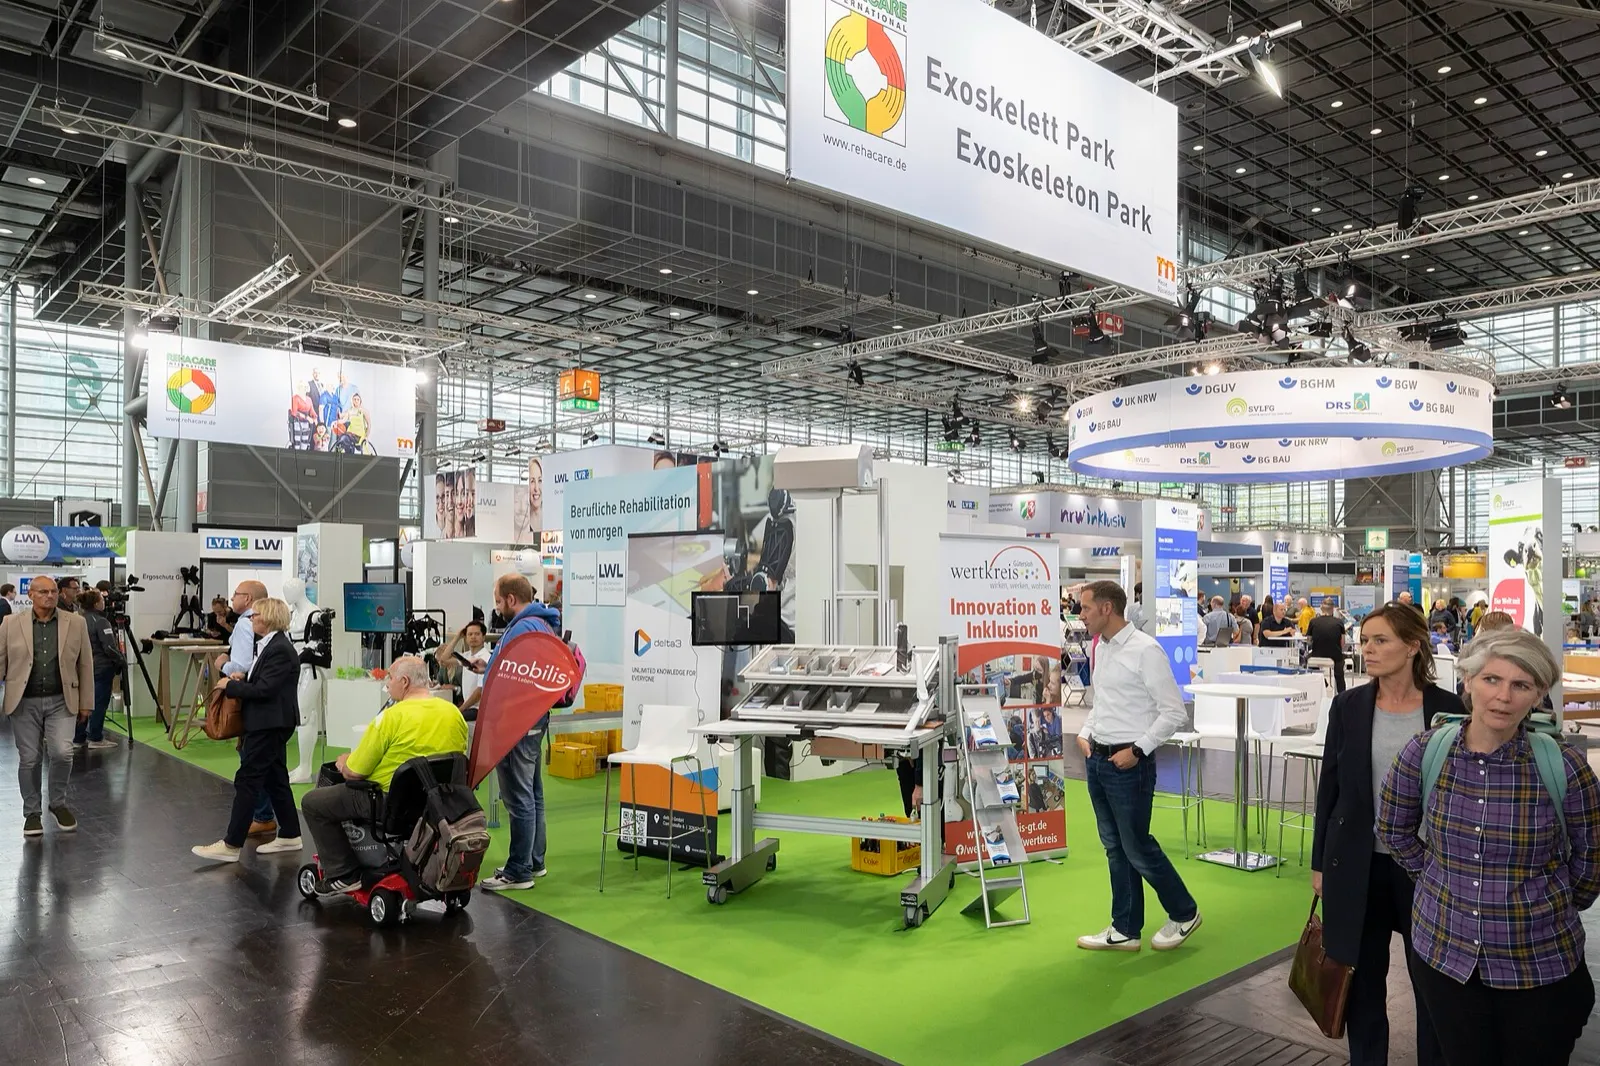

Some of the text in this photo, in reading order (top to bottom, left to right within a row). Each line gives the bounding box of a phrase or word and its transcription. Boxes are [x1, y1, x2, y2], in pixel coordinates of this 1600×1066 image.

[926, 56, 1116, 170] Exoskelett Park
[823, 133, 907, 172] www.rehacare.de
[956, 127, 1153, 235] Exoskeleton Park
[167, 353, 217, 367] REHACARE
[583, 380, 593, 398] 6
[1205, 383, 1236, 394] DGUV
[1300, 378, 1335, 389] BGHM
[1394, 379, 1418, 390] BGW
[1458, 385, 1480, 398] UK NRW
[1125, 393, 1157, 406] UK NRW
[1248, 405, 1275, 413] SVLFG
[1326, 401, 1351, 410] DRS
[1426, 403, 1455, 415] BG BAU
[1082, 406, 1093, 418] BGW
[1097, 418, 1121, 431] BG BAU
[1294, 438, 1328, 447] UK NRW
[1258, 455, 1290, 464] BG BAU
[554, 473, 569, 483] LWL
[570, 494, 691, 519] Berufliche Rehabilitation
[1060, 504, 1126, 528] nrw inklusiv
[14, 533, 45, 544] LWL
[570, 525, 623, 541] von morgen
[208, 538, 232, 548] LVR
[255, 539, 282, 550] LW
[1273, 541, 1290, 552] VdK
[598, 563, 624, 578] LWL
[950, 560, 1019, 580] wertkreis
[142, 573, 174, 581] Ergoschutz
[443, 576, 468, 585] skelex
[989, 582, 1052, 590] wirken, werken, wohnen
[950, 598, 1052, 615] Innovation &
[967, 620, 1038, 638] Inklusion
[654, 639, 682, 648] delta3
[499, 659, 567, 684] mobilis
[657, 668, 686, 676] KNOWLEDGE
[863, 857, 880, 866] Coke
